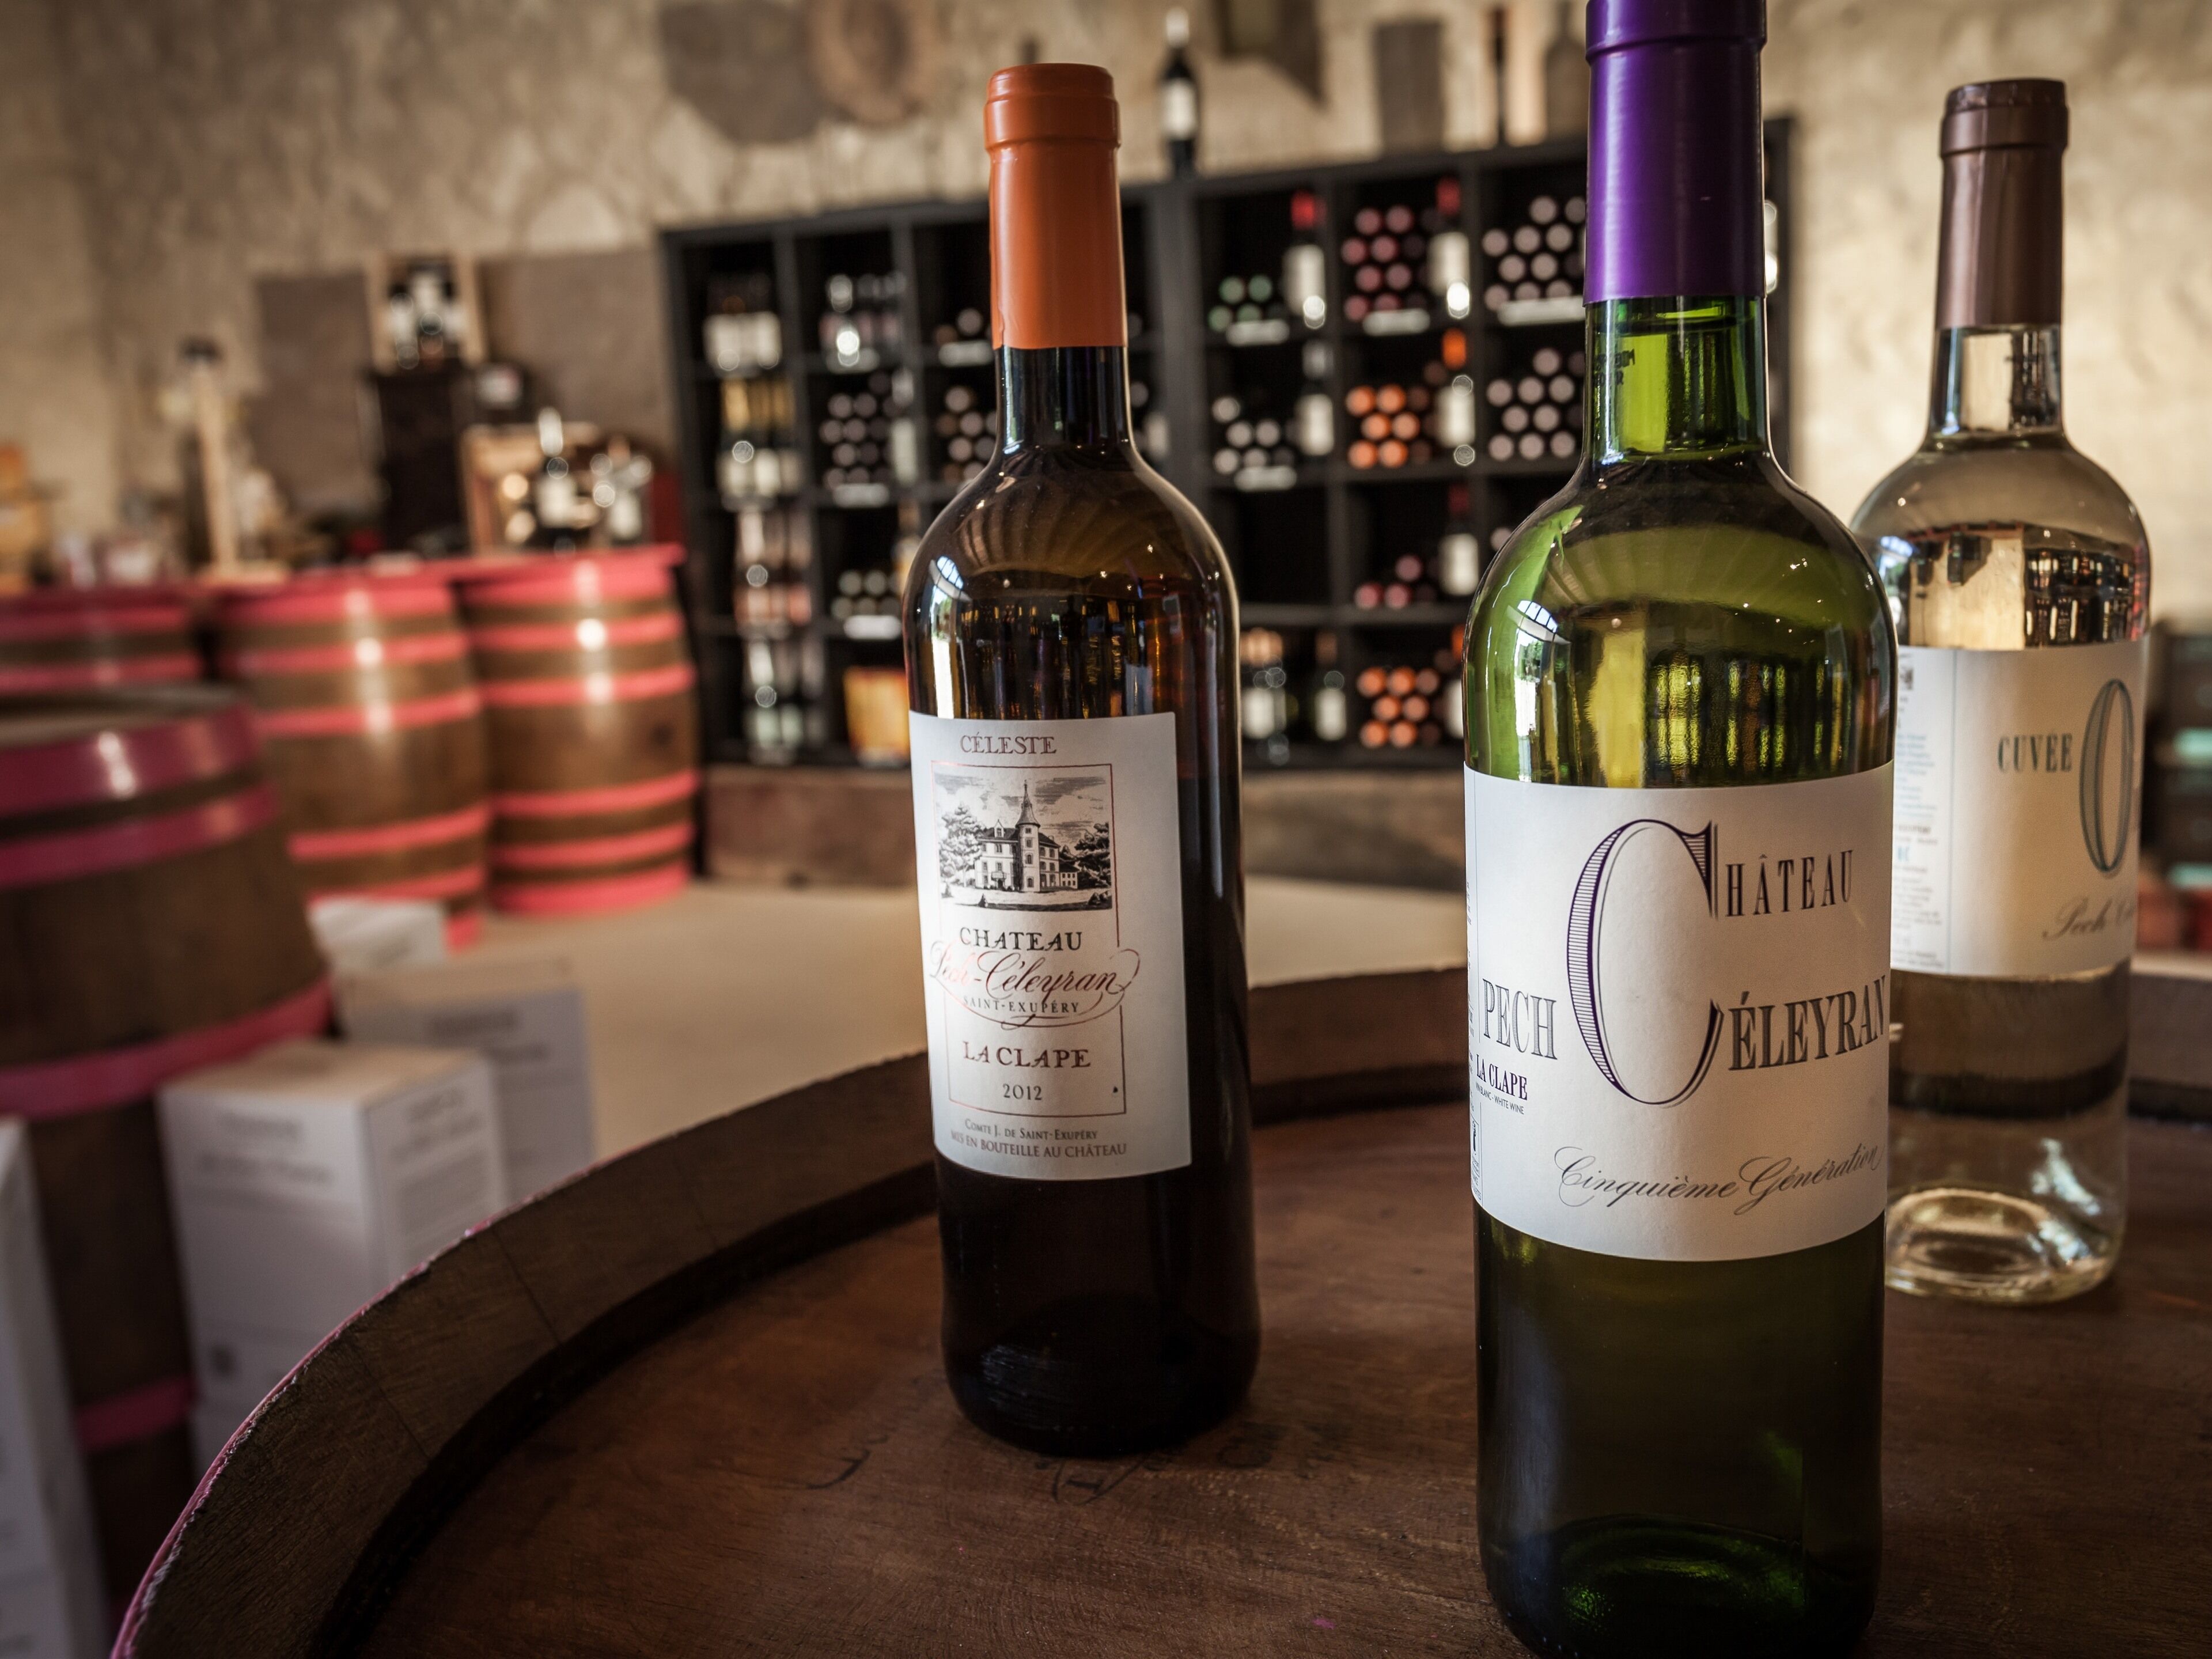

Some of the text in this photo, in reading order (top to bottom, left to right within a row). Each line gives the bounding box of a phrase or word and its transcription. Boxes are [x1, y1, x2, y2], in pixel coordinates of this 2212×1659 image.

[960, 732, 1057, 755] CÉLESTE
[960, 926, 1083, 952] CHATEAU
[963, 995, 1080, 1013] SAINT-EXUPÉRY
[1482, 978, 1558, 1060] PECH
[963, 1040, 1092, 1069] LA CLAPE
[1476, 1054, 1528, 1101] LA CLAPE
[1002, 1083, 1043, 1101] 2012
[1494, 1095, 1509, 1109] WHITE
[1509, 1100, 1525, 1115] WINE
[965, 1134, 978, 1148] EN
[980, 1139, 1040, 1157] BOUTEILLE
[1044, 1146, 1061, 1158] AU
[1065, 1142, 1127, 1158] CHÂTEAU
